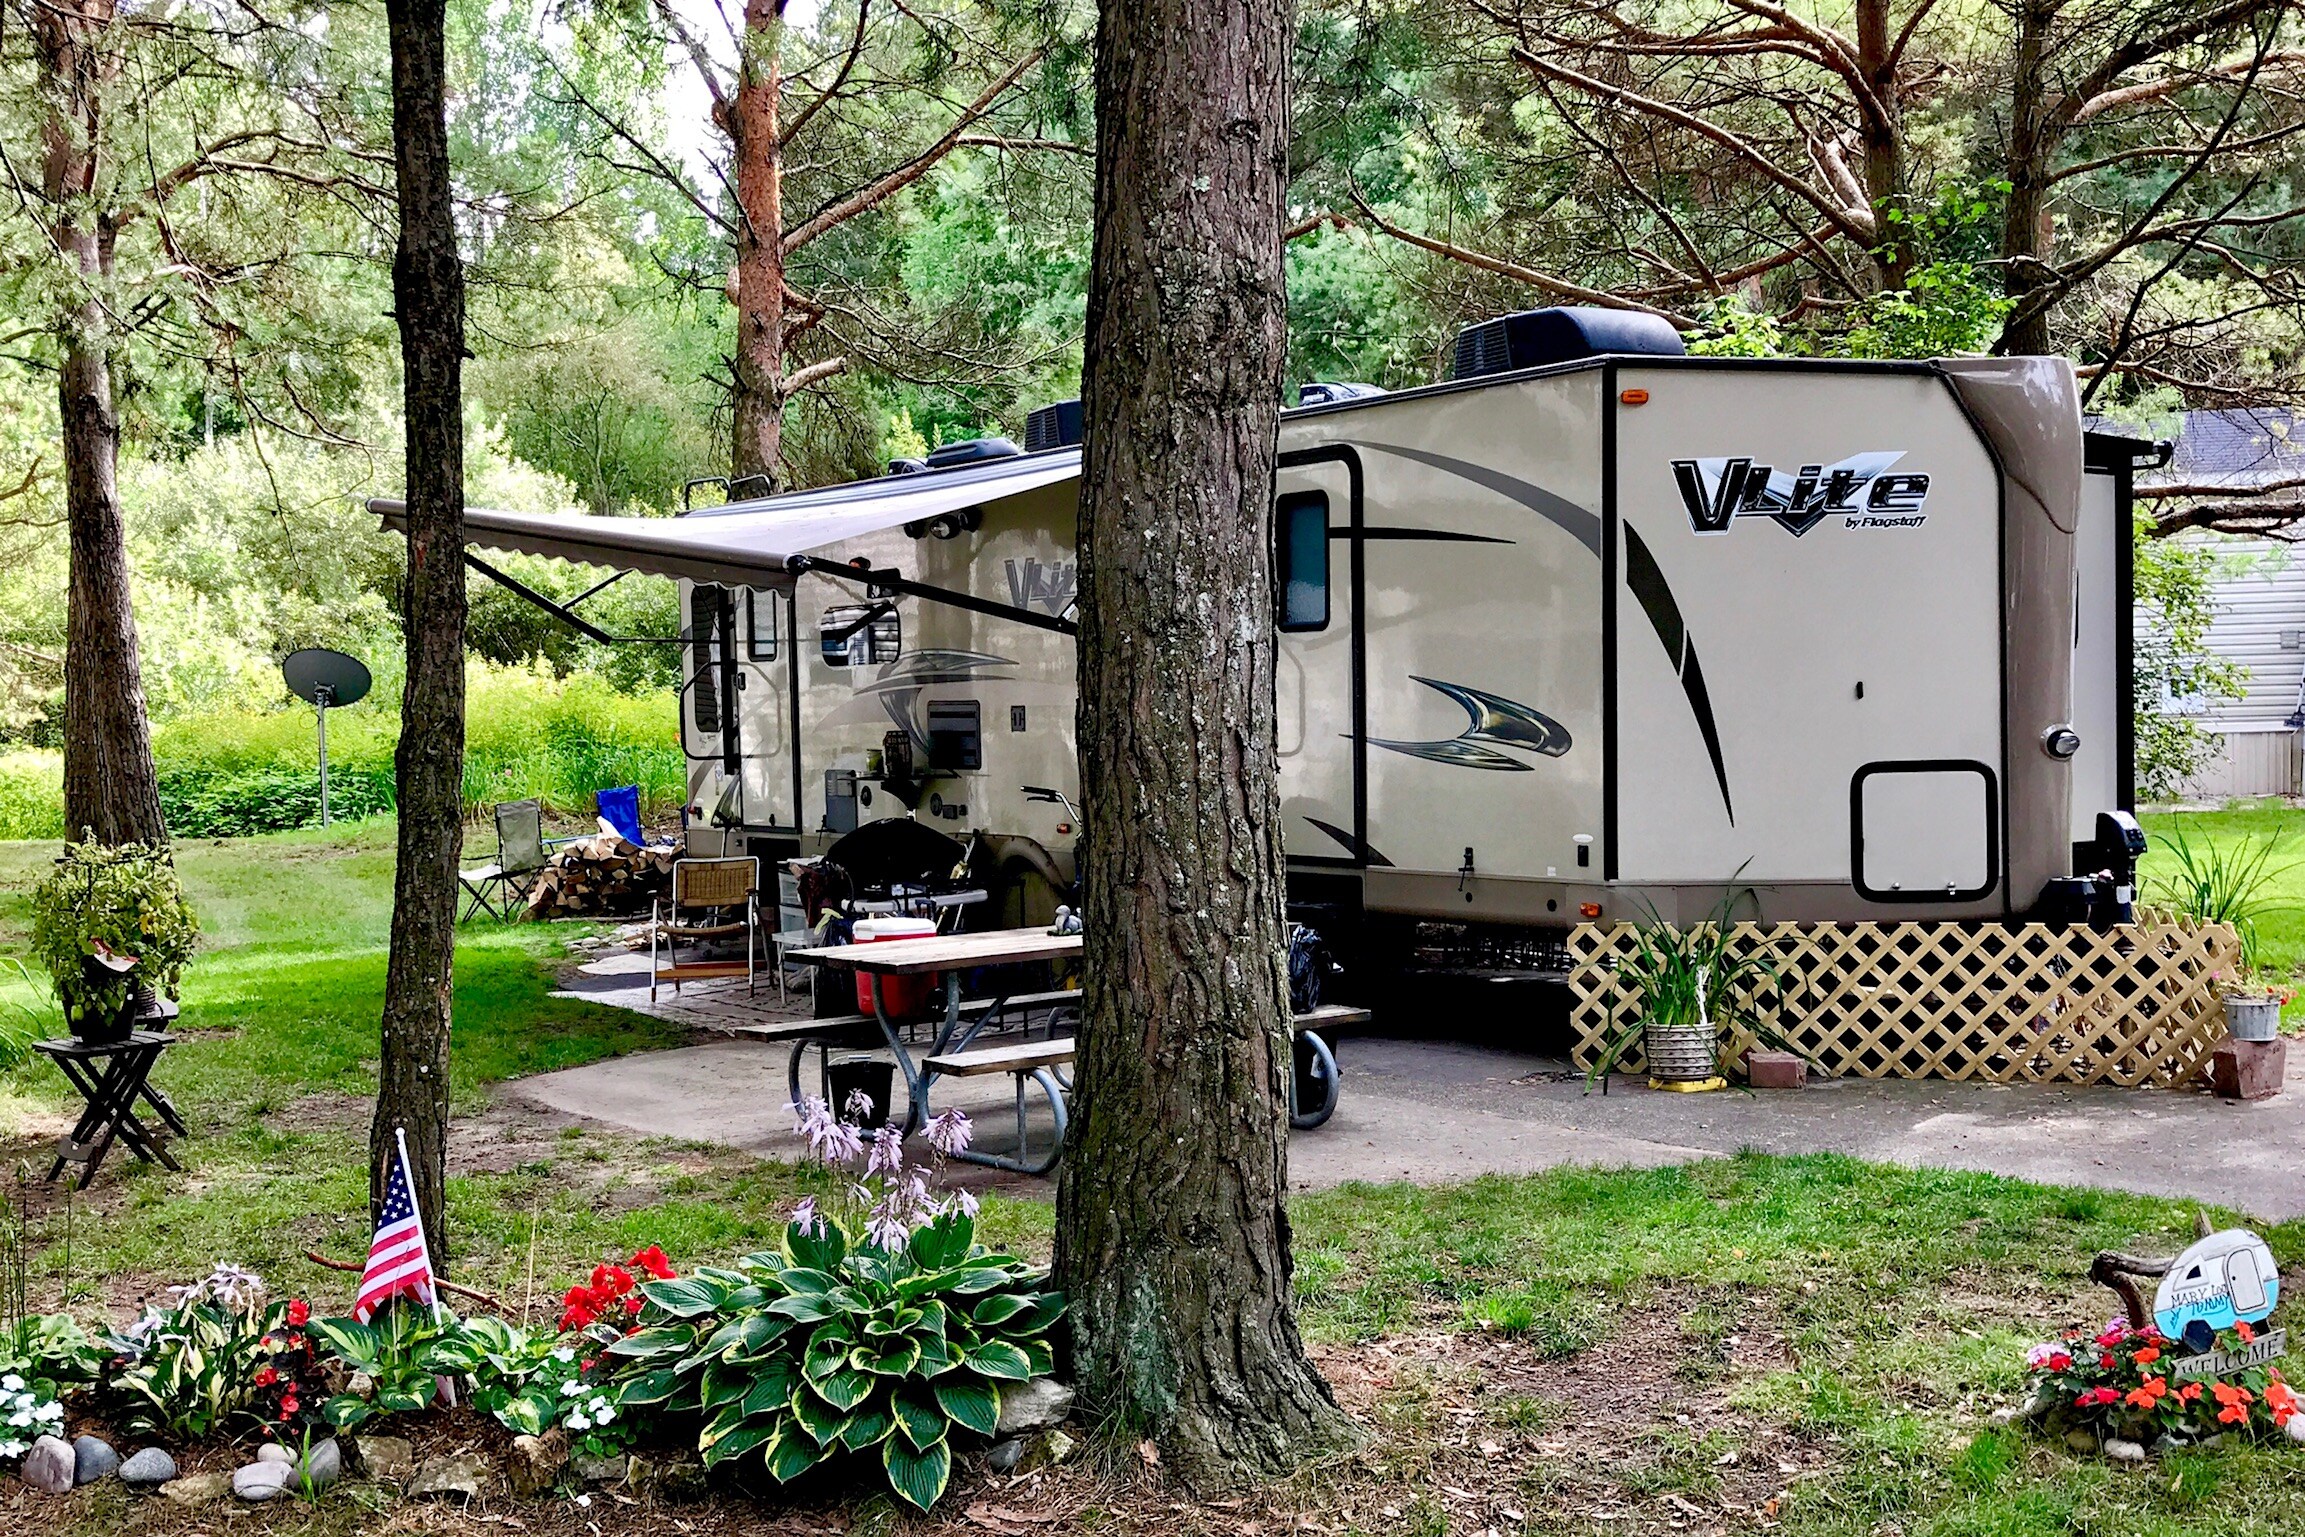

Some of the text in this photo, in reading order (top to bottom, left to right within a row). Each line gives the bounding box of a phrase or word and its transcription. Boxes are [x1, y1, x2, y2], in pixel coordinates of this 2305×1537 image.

[1845, 516, 1927, 530] by Flagstaff
[1003, 557, 1077, 611] VLit
[2171, 1287, 2207, 1309] MARY
[2182, 1338, 2278, 1374] WELCOME
